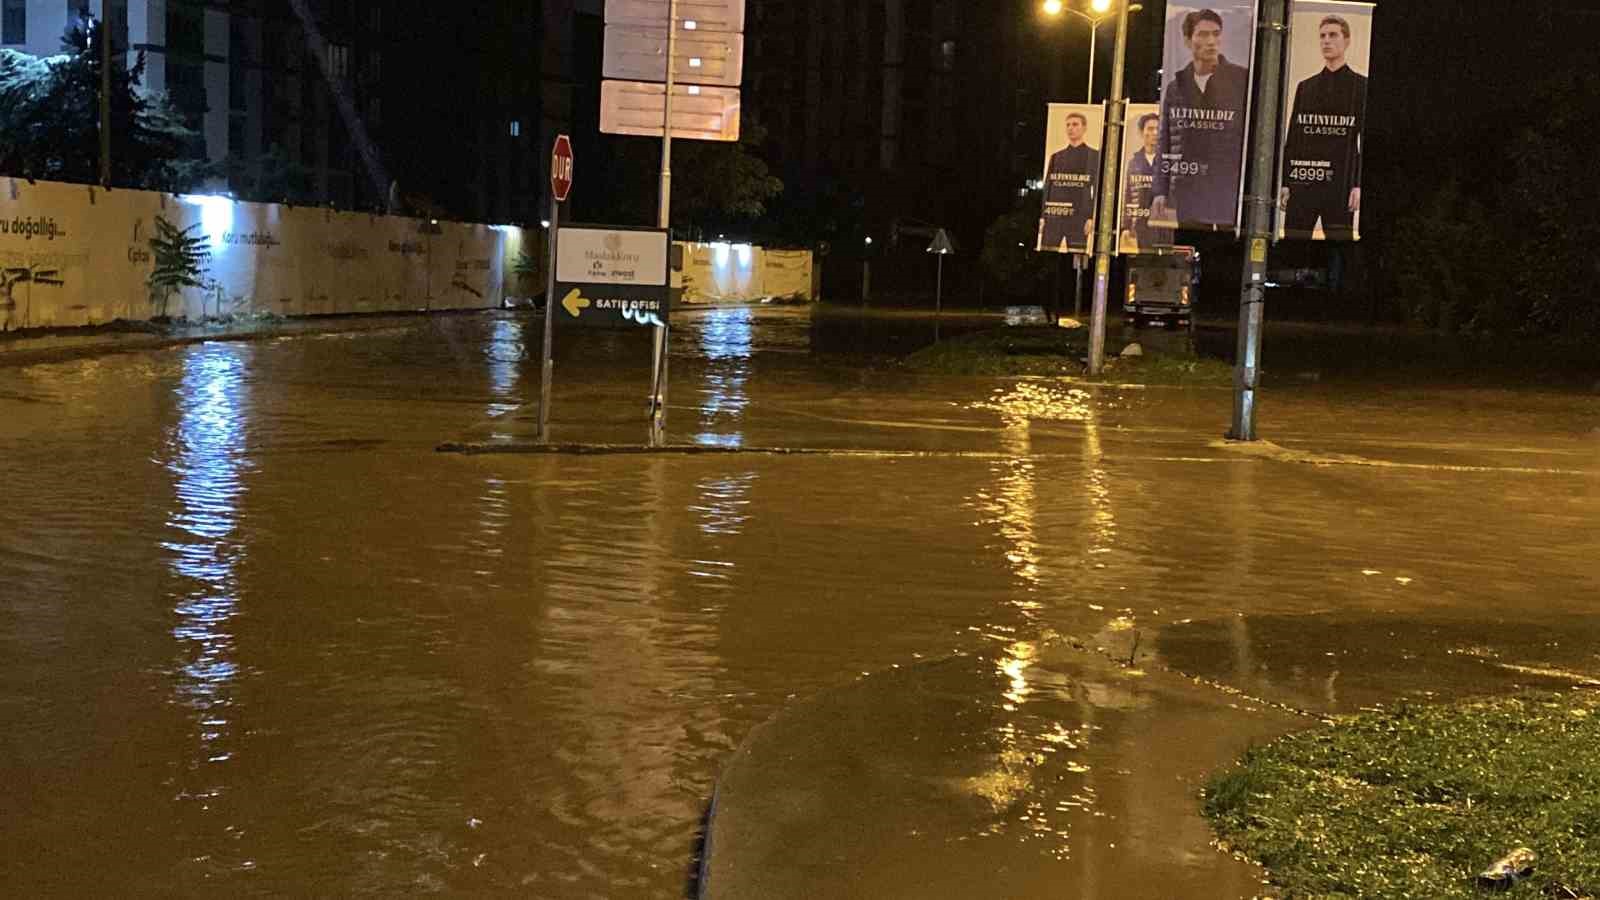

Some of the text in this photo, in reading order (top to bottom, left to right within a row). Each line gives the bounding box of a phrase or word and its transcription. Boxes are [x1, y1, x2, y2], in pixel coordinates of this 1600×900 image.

[1169, 107, 1236, 120] ALTINYILDIZ
[1297, 113, 1356, 127] ALTINYILDIZ
[1177, 120, 1225, 130] CLASSICS
[1303, 126, 1347, 136] CLASSICS
[553, 154, 571, 181] DUR
[1160, 161, 1199, 175] 3499
[1290, 167, 1325, 181] 4999
